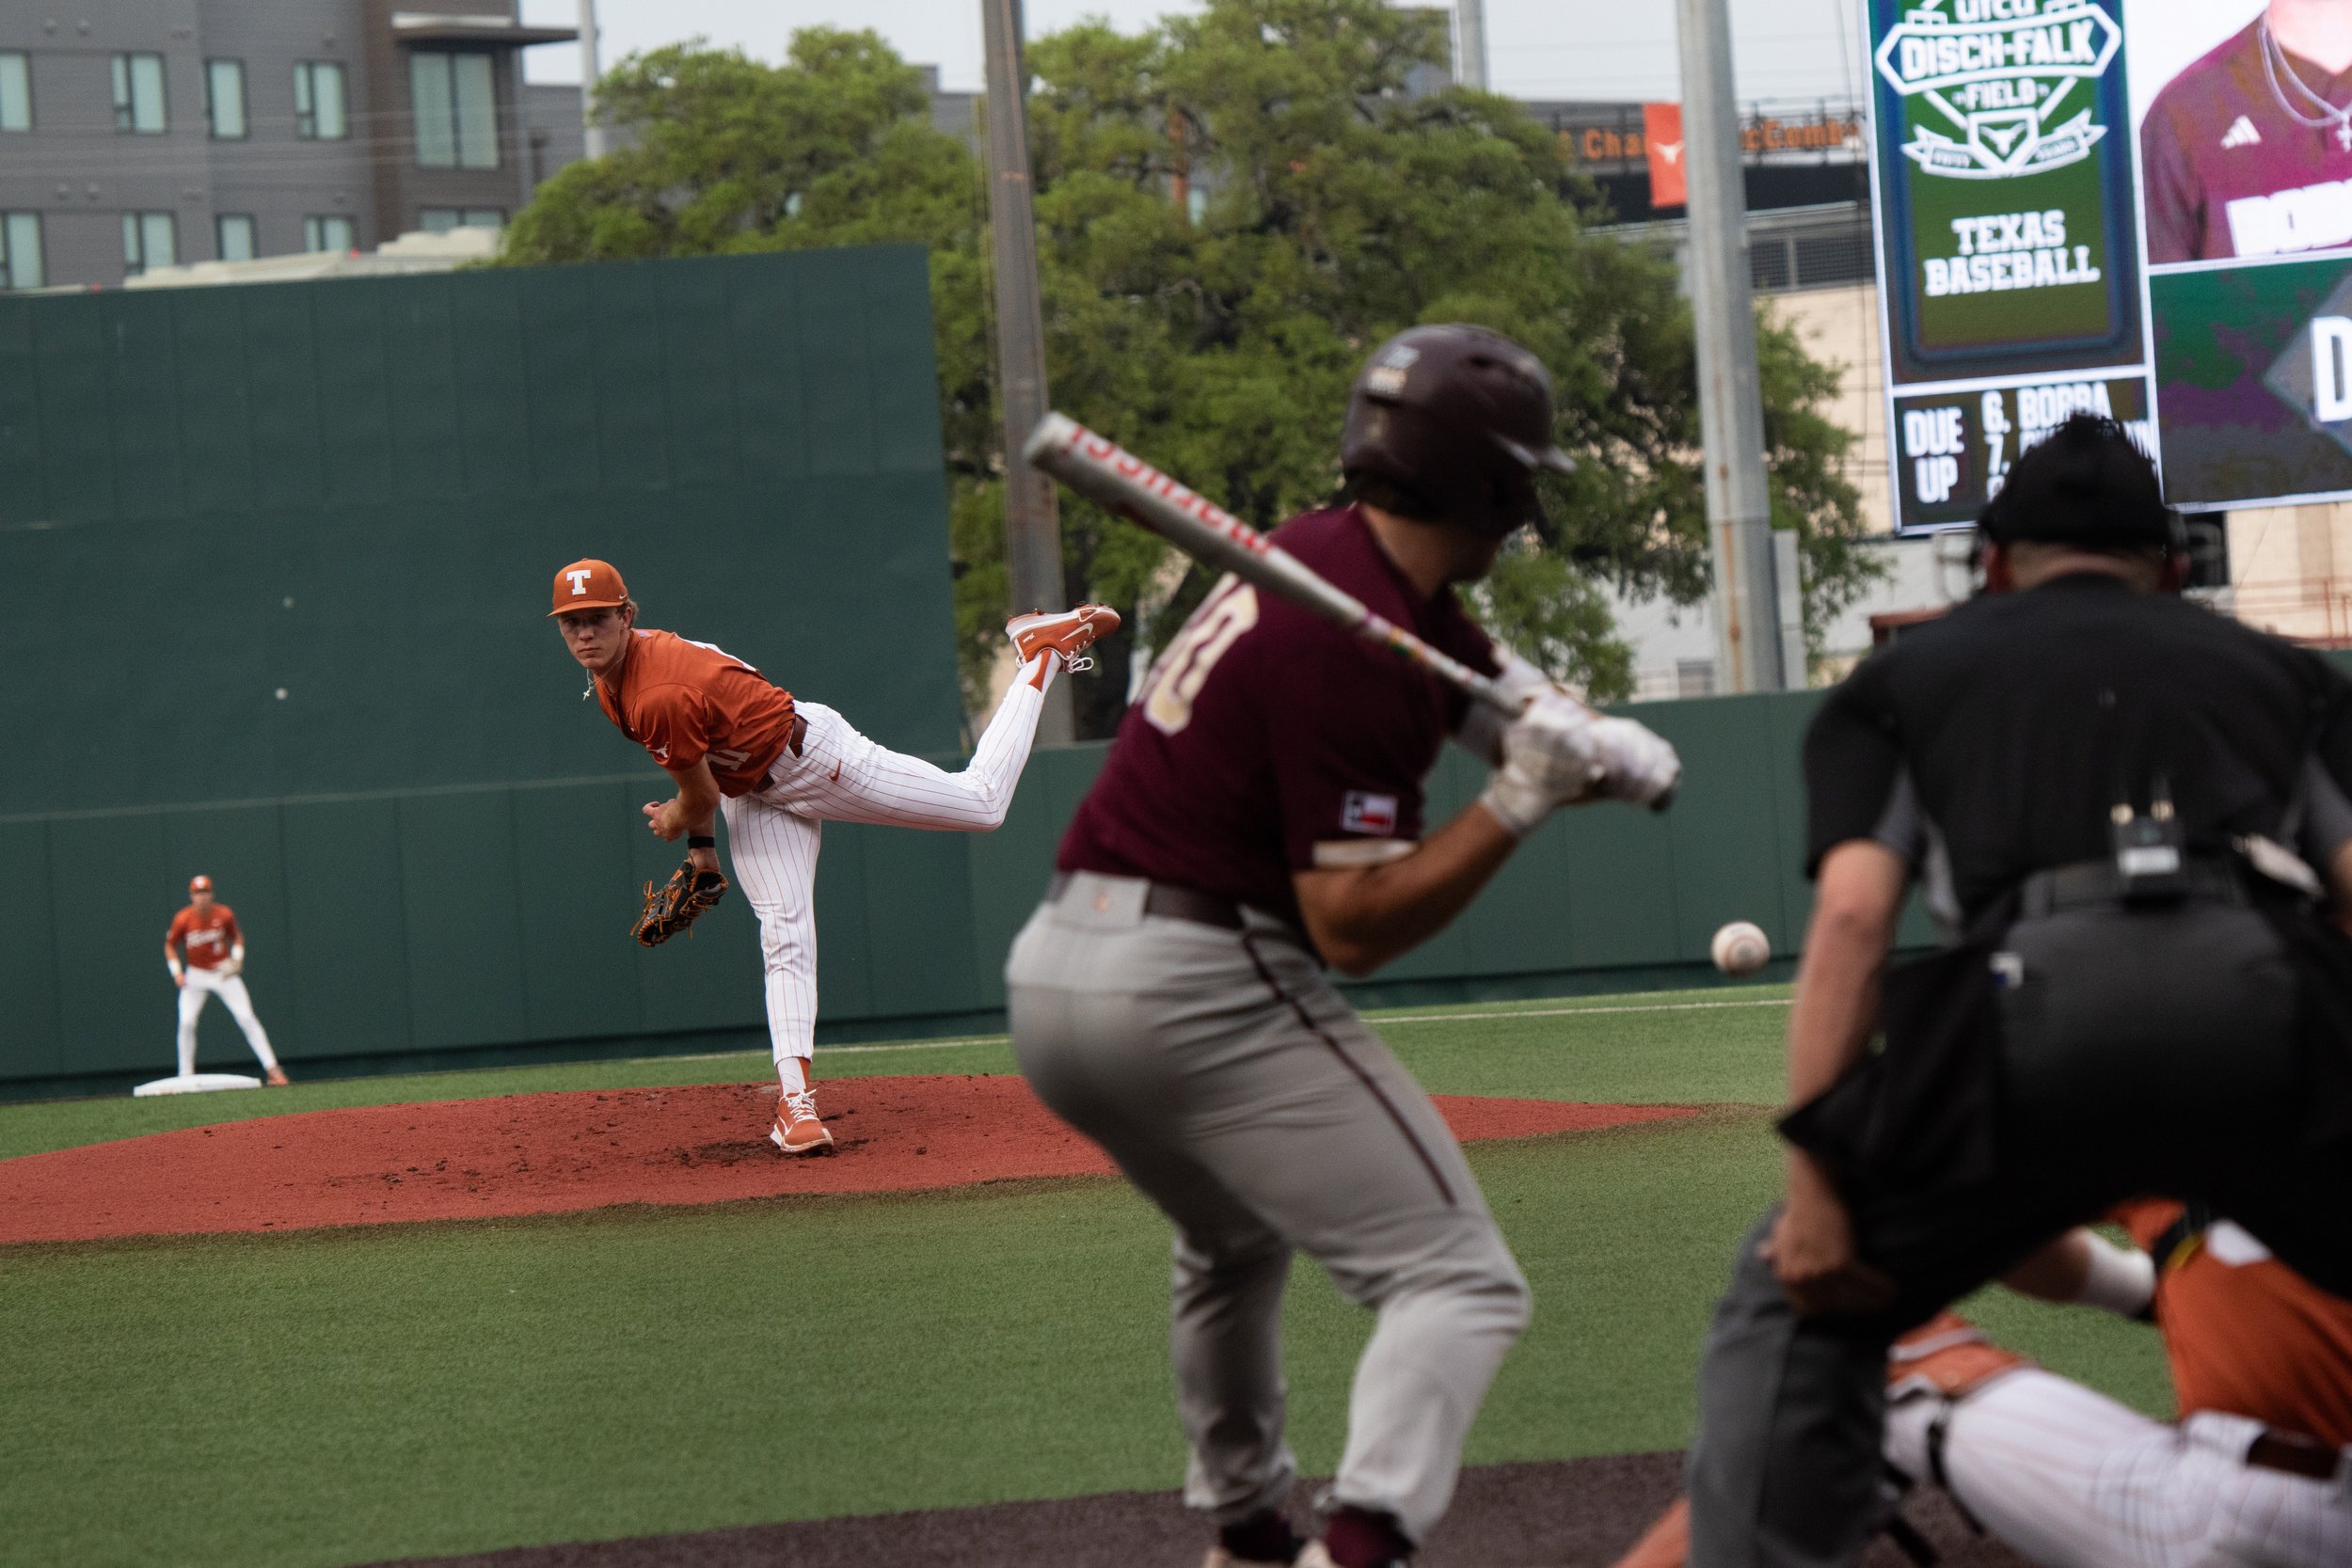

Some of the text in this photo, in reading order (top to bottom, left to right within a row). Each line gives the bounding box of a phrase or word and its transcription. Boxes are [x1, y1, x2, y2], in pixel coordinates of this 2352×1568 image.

[1899, 19, 2097, 81] DISCH-FALK
[1963, 77, 2038, 111] FIELD
[1950, 209, 2066, 256] TEXAS
[1922, 245, 2102, 297] BASEBALL
[1903, 406, 1965, 457] DUE
[1980, 389, 2011, 435] 6.
[1984, 432, 2011, 476] 7.
[1915, 455, 1959, 503] UP
[566, 569, 592, 596] T
